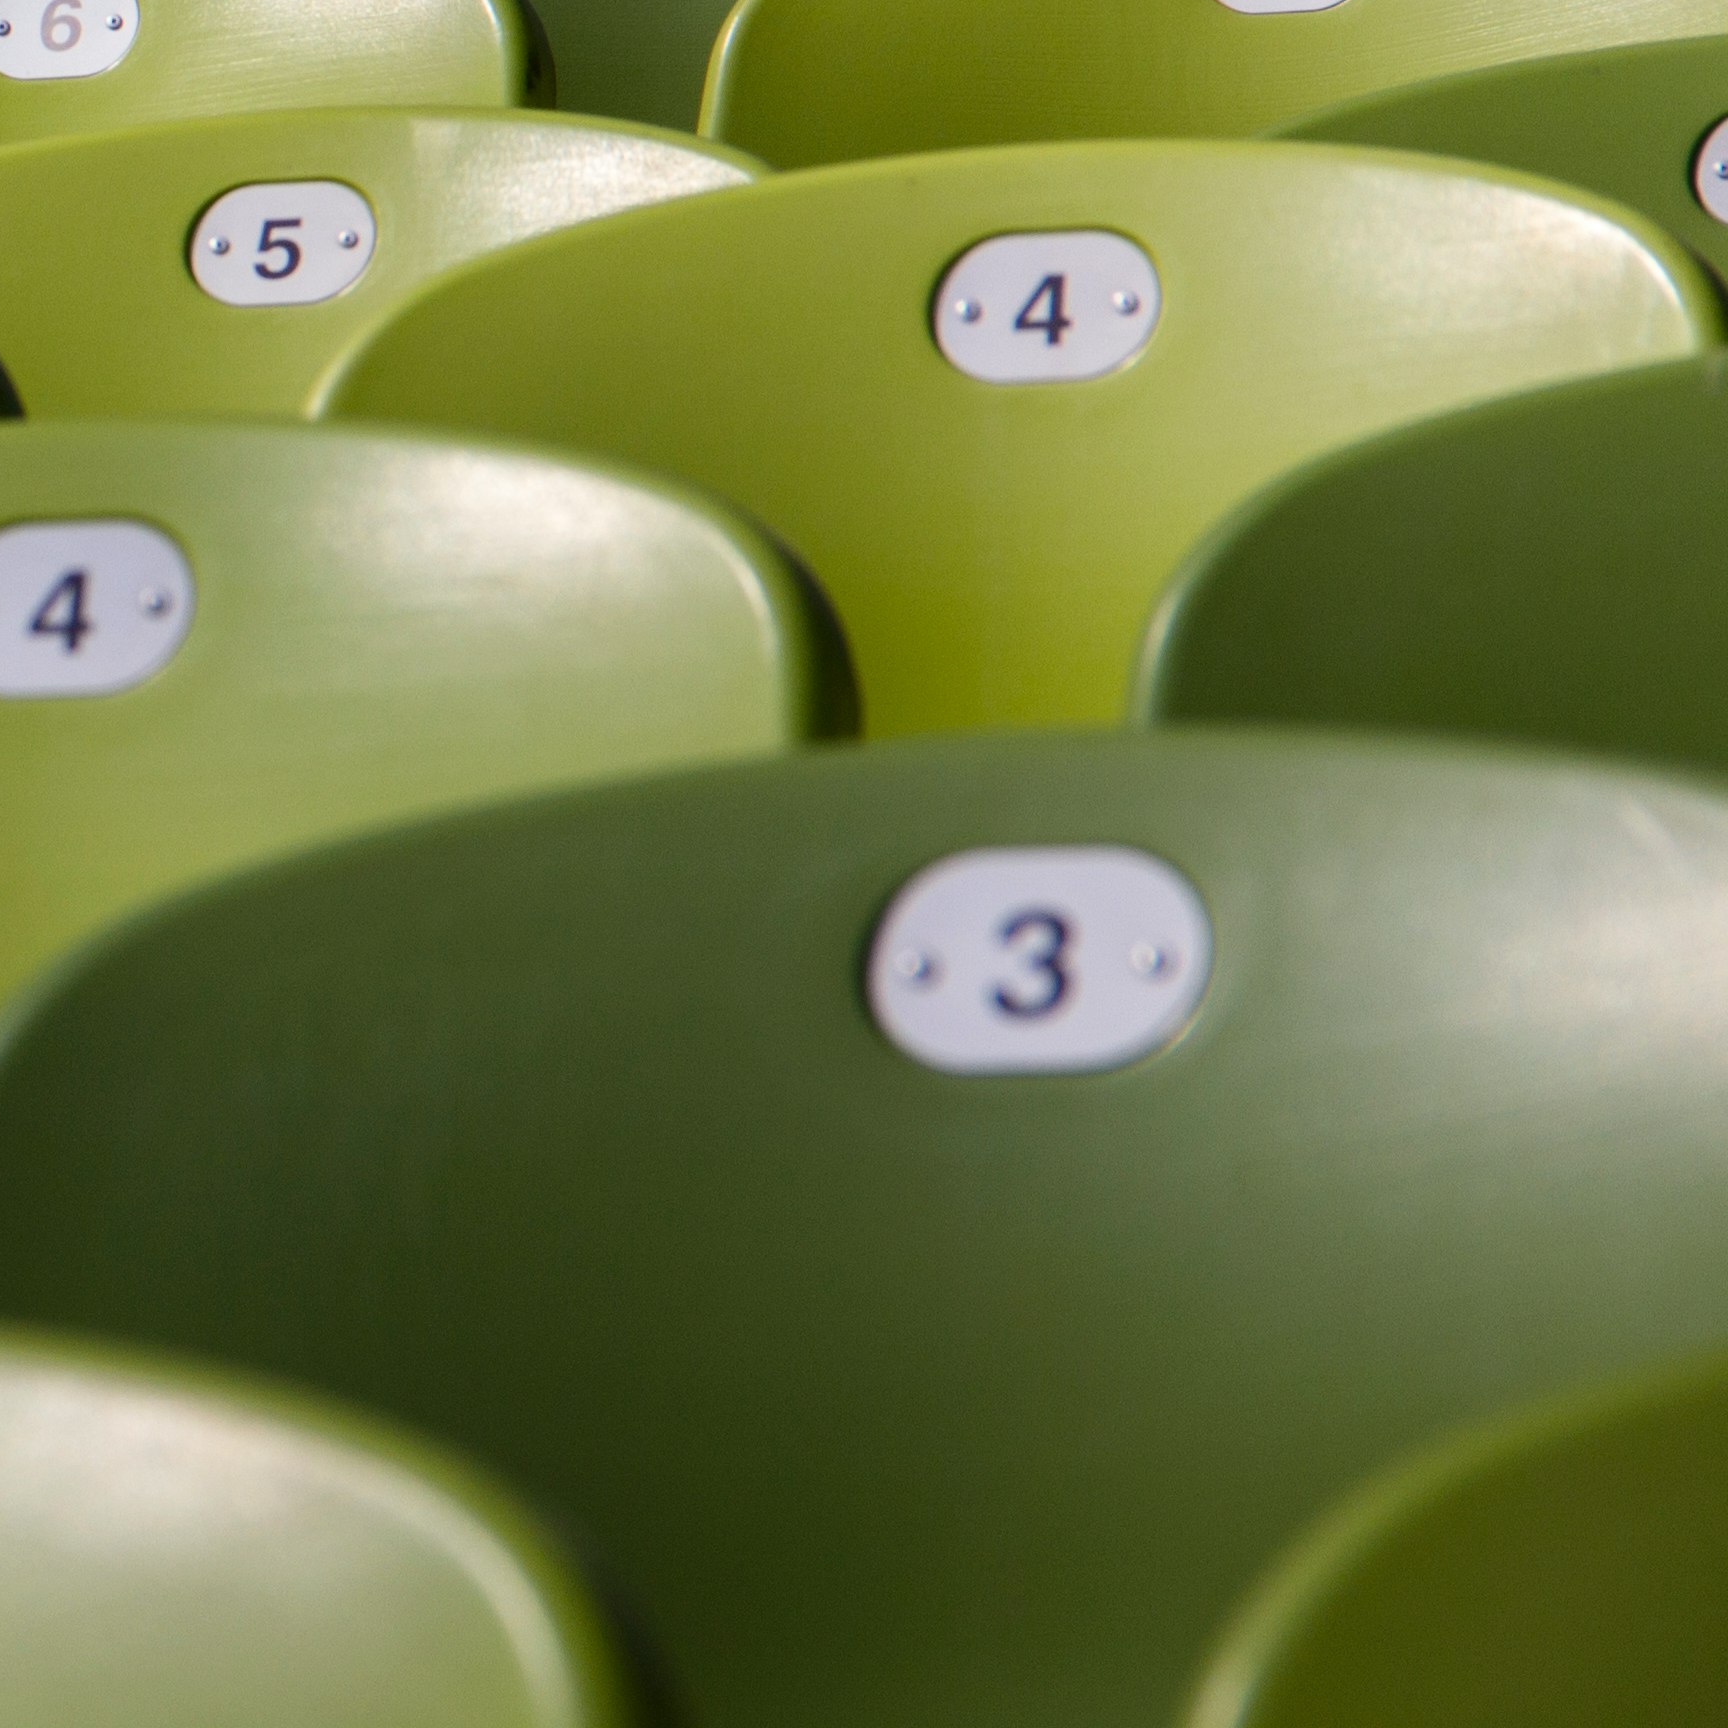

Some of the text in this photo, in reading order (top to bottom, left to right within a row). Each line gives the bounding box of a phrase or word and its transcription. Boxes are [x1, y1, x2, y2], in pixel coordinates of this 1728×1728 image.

[254, 217, 302, 281] 5
[1013, 273, 1071, 346] 4
[28, 568, 92, 654] 4
[990, 908, 1074, 1022] 3
